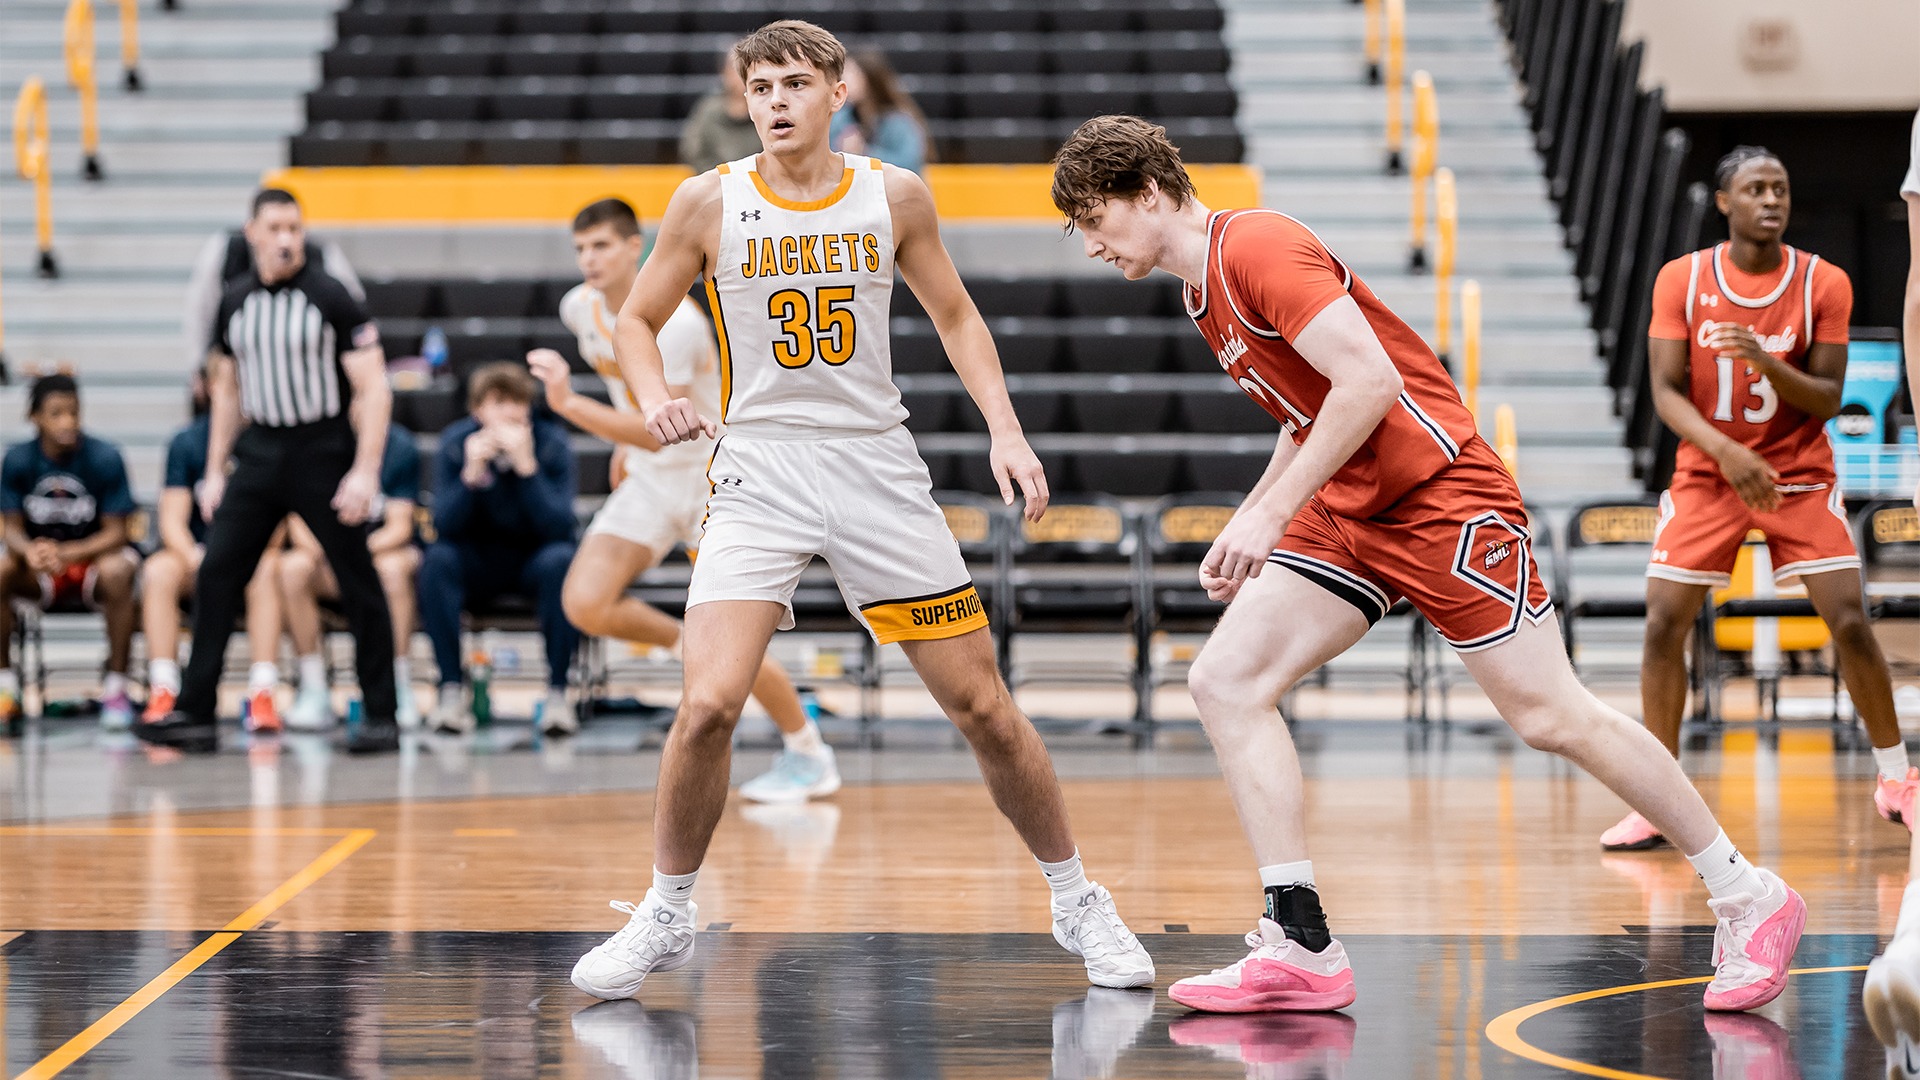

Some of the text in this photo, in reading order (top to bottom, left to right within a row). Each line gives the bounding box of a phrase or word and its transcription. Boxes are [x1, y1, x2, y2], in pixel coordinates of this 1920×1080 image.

[741, 233, 880, 279] JACKETS
[767, 285, 857, 370] 35
[1697, 319, 1798, 353] Cnals
[1238, 365, 1312, 434] 21
[1713, 356, 1779, 423] 13
